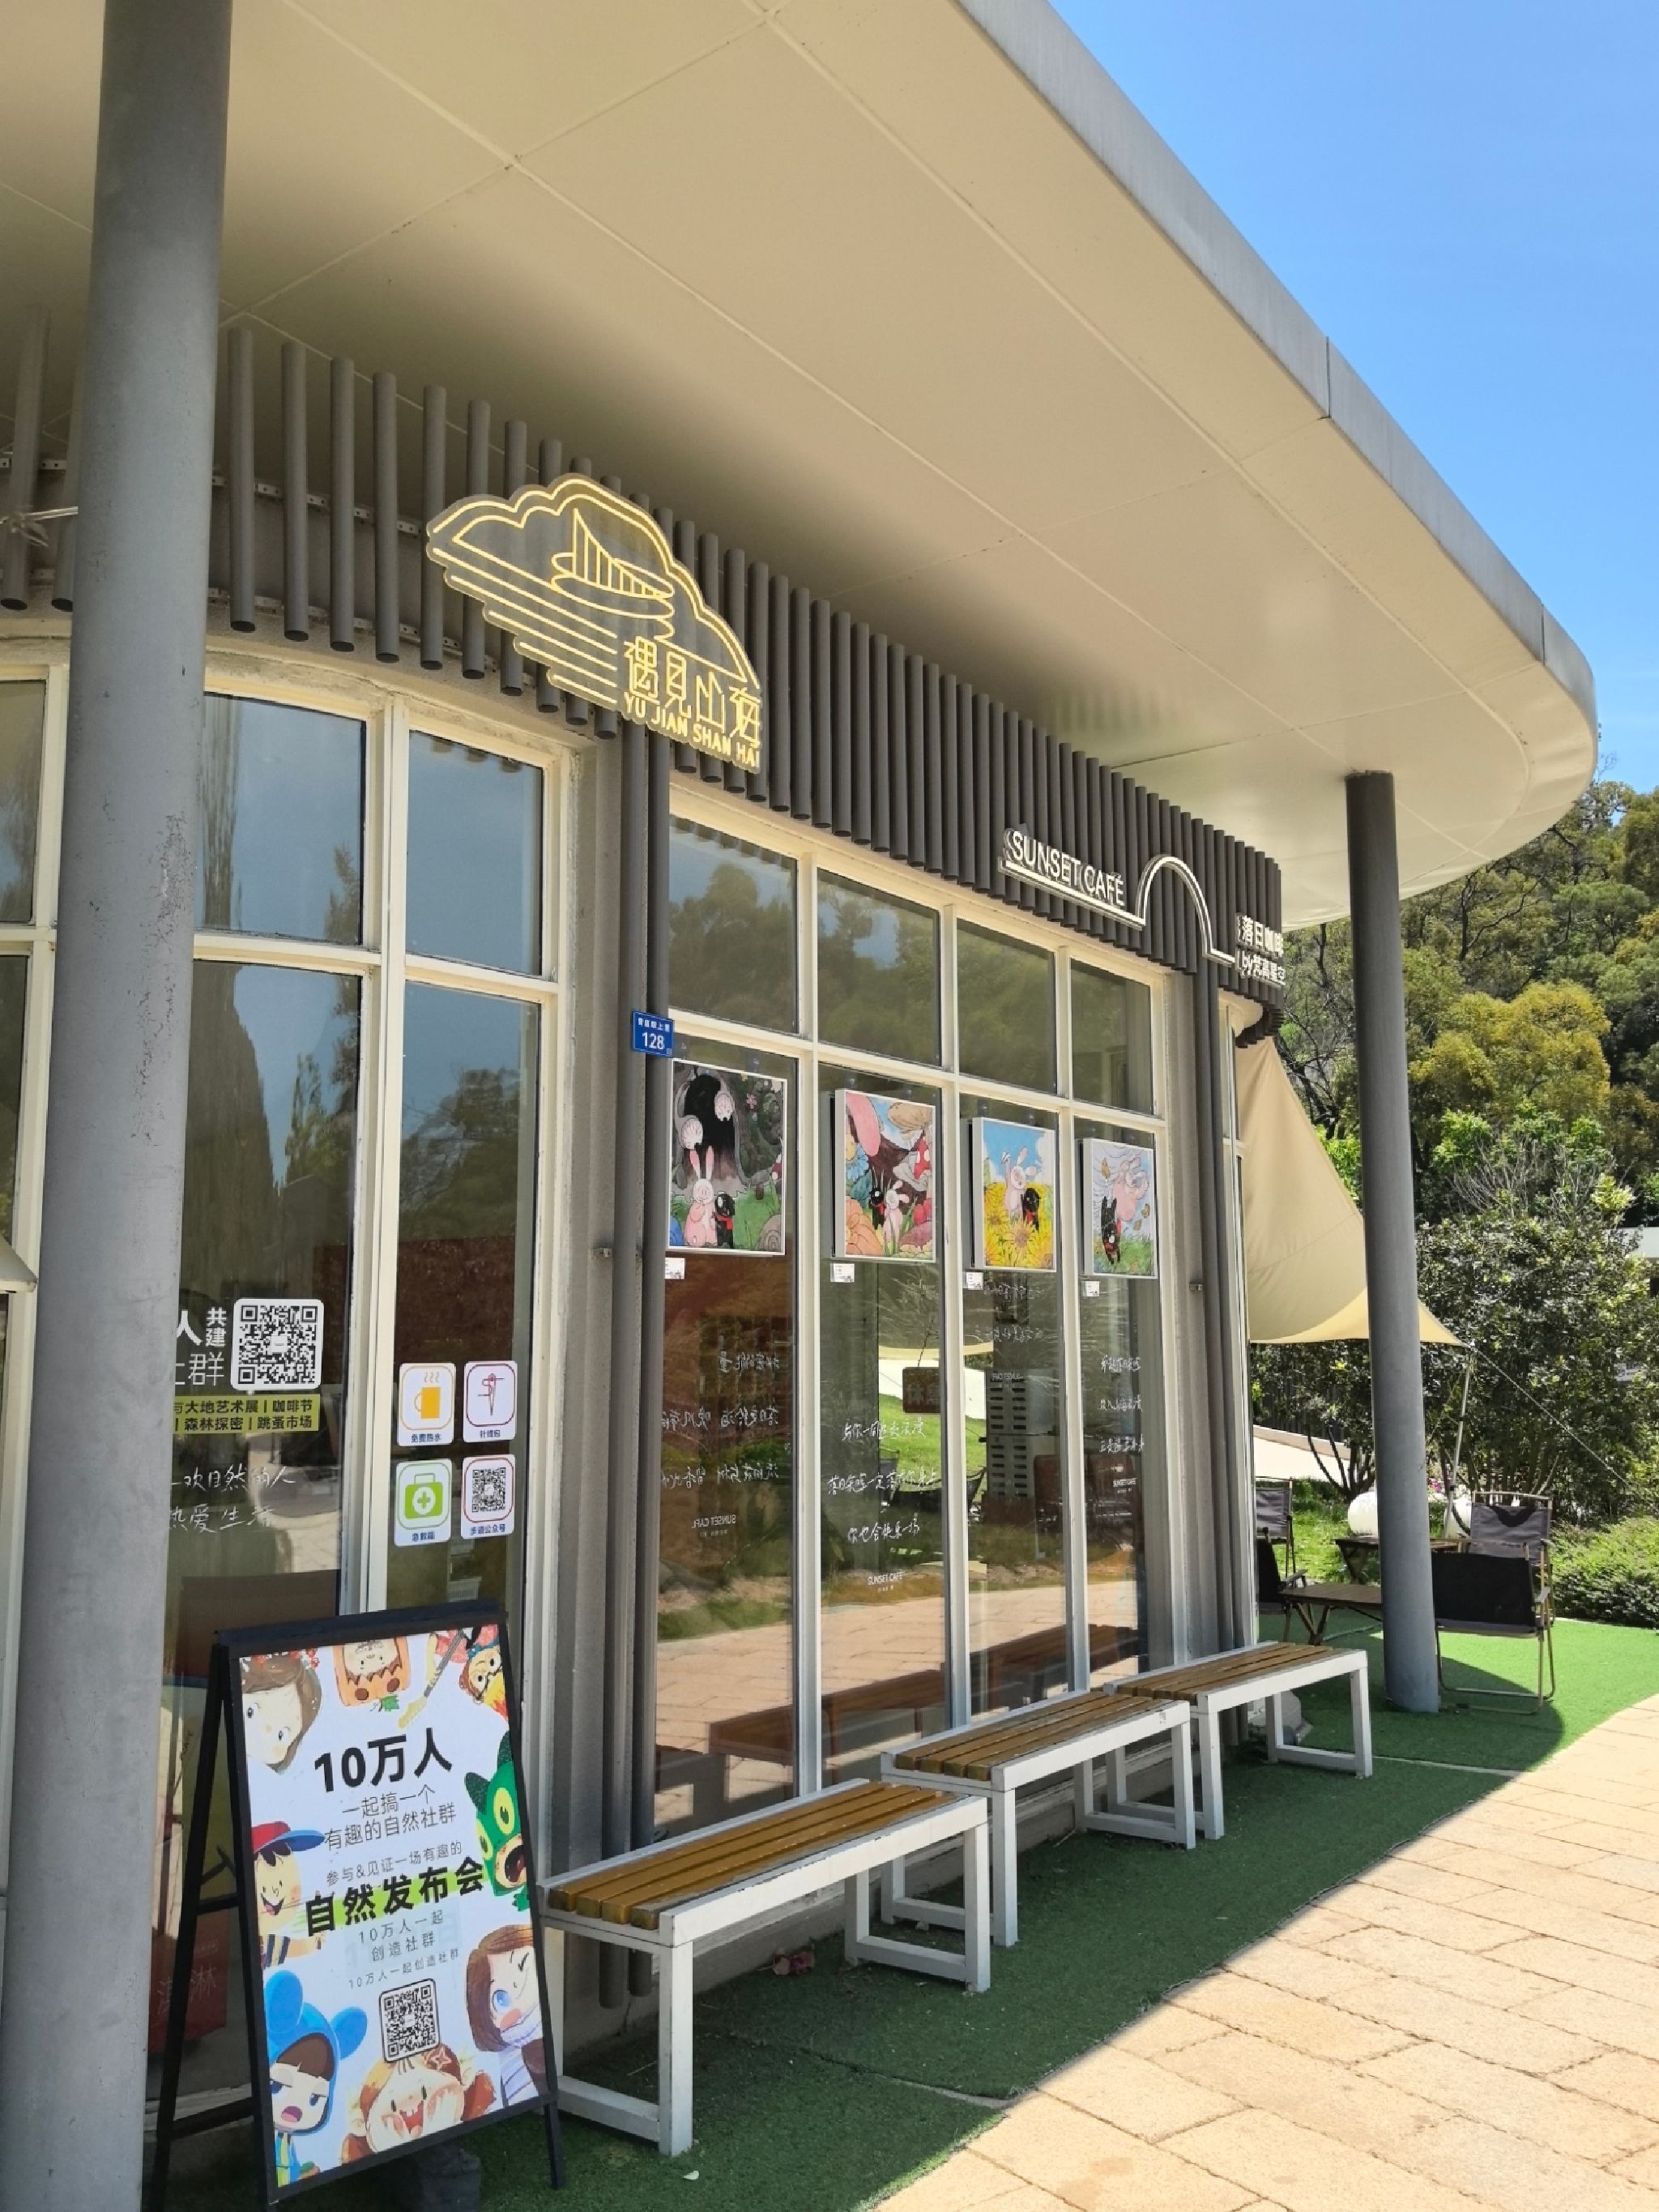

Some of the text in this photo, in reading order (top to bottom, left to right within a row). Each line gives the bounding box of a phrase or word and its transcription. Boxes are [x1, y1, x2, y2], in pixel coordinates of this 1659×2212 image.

[624, 692, 761, 768] YU JIAN SHAN HAI
[1012, 831, 1081, 886] SUNSET
[642, 1031, 664, 1050] 128
[258, 1416, 313, 1430] 跳蚤市场
[272, 1399, 313, 1413] 咖啡节
[171, 1463, 297, 1492] 欢自然的人
[313, 1727, 453, 1792] 10万人
[342, 1784, 436, 1818] 一起搞一个
[324, 1801, 458, 1851] 有趣的自然社群
[326, 1840, 463, 1886] 参与&见证一场有趣的
[305, 1856, 487, 1937] 自然发布会
[358, 1909, 444, 1944] 10万人一起
[372, 1930, 436, 1962] 创造社群
[348, 1948, 460, 1989] 10万人一起创造社群
